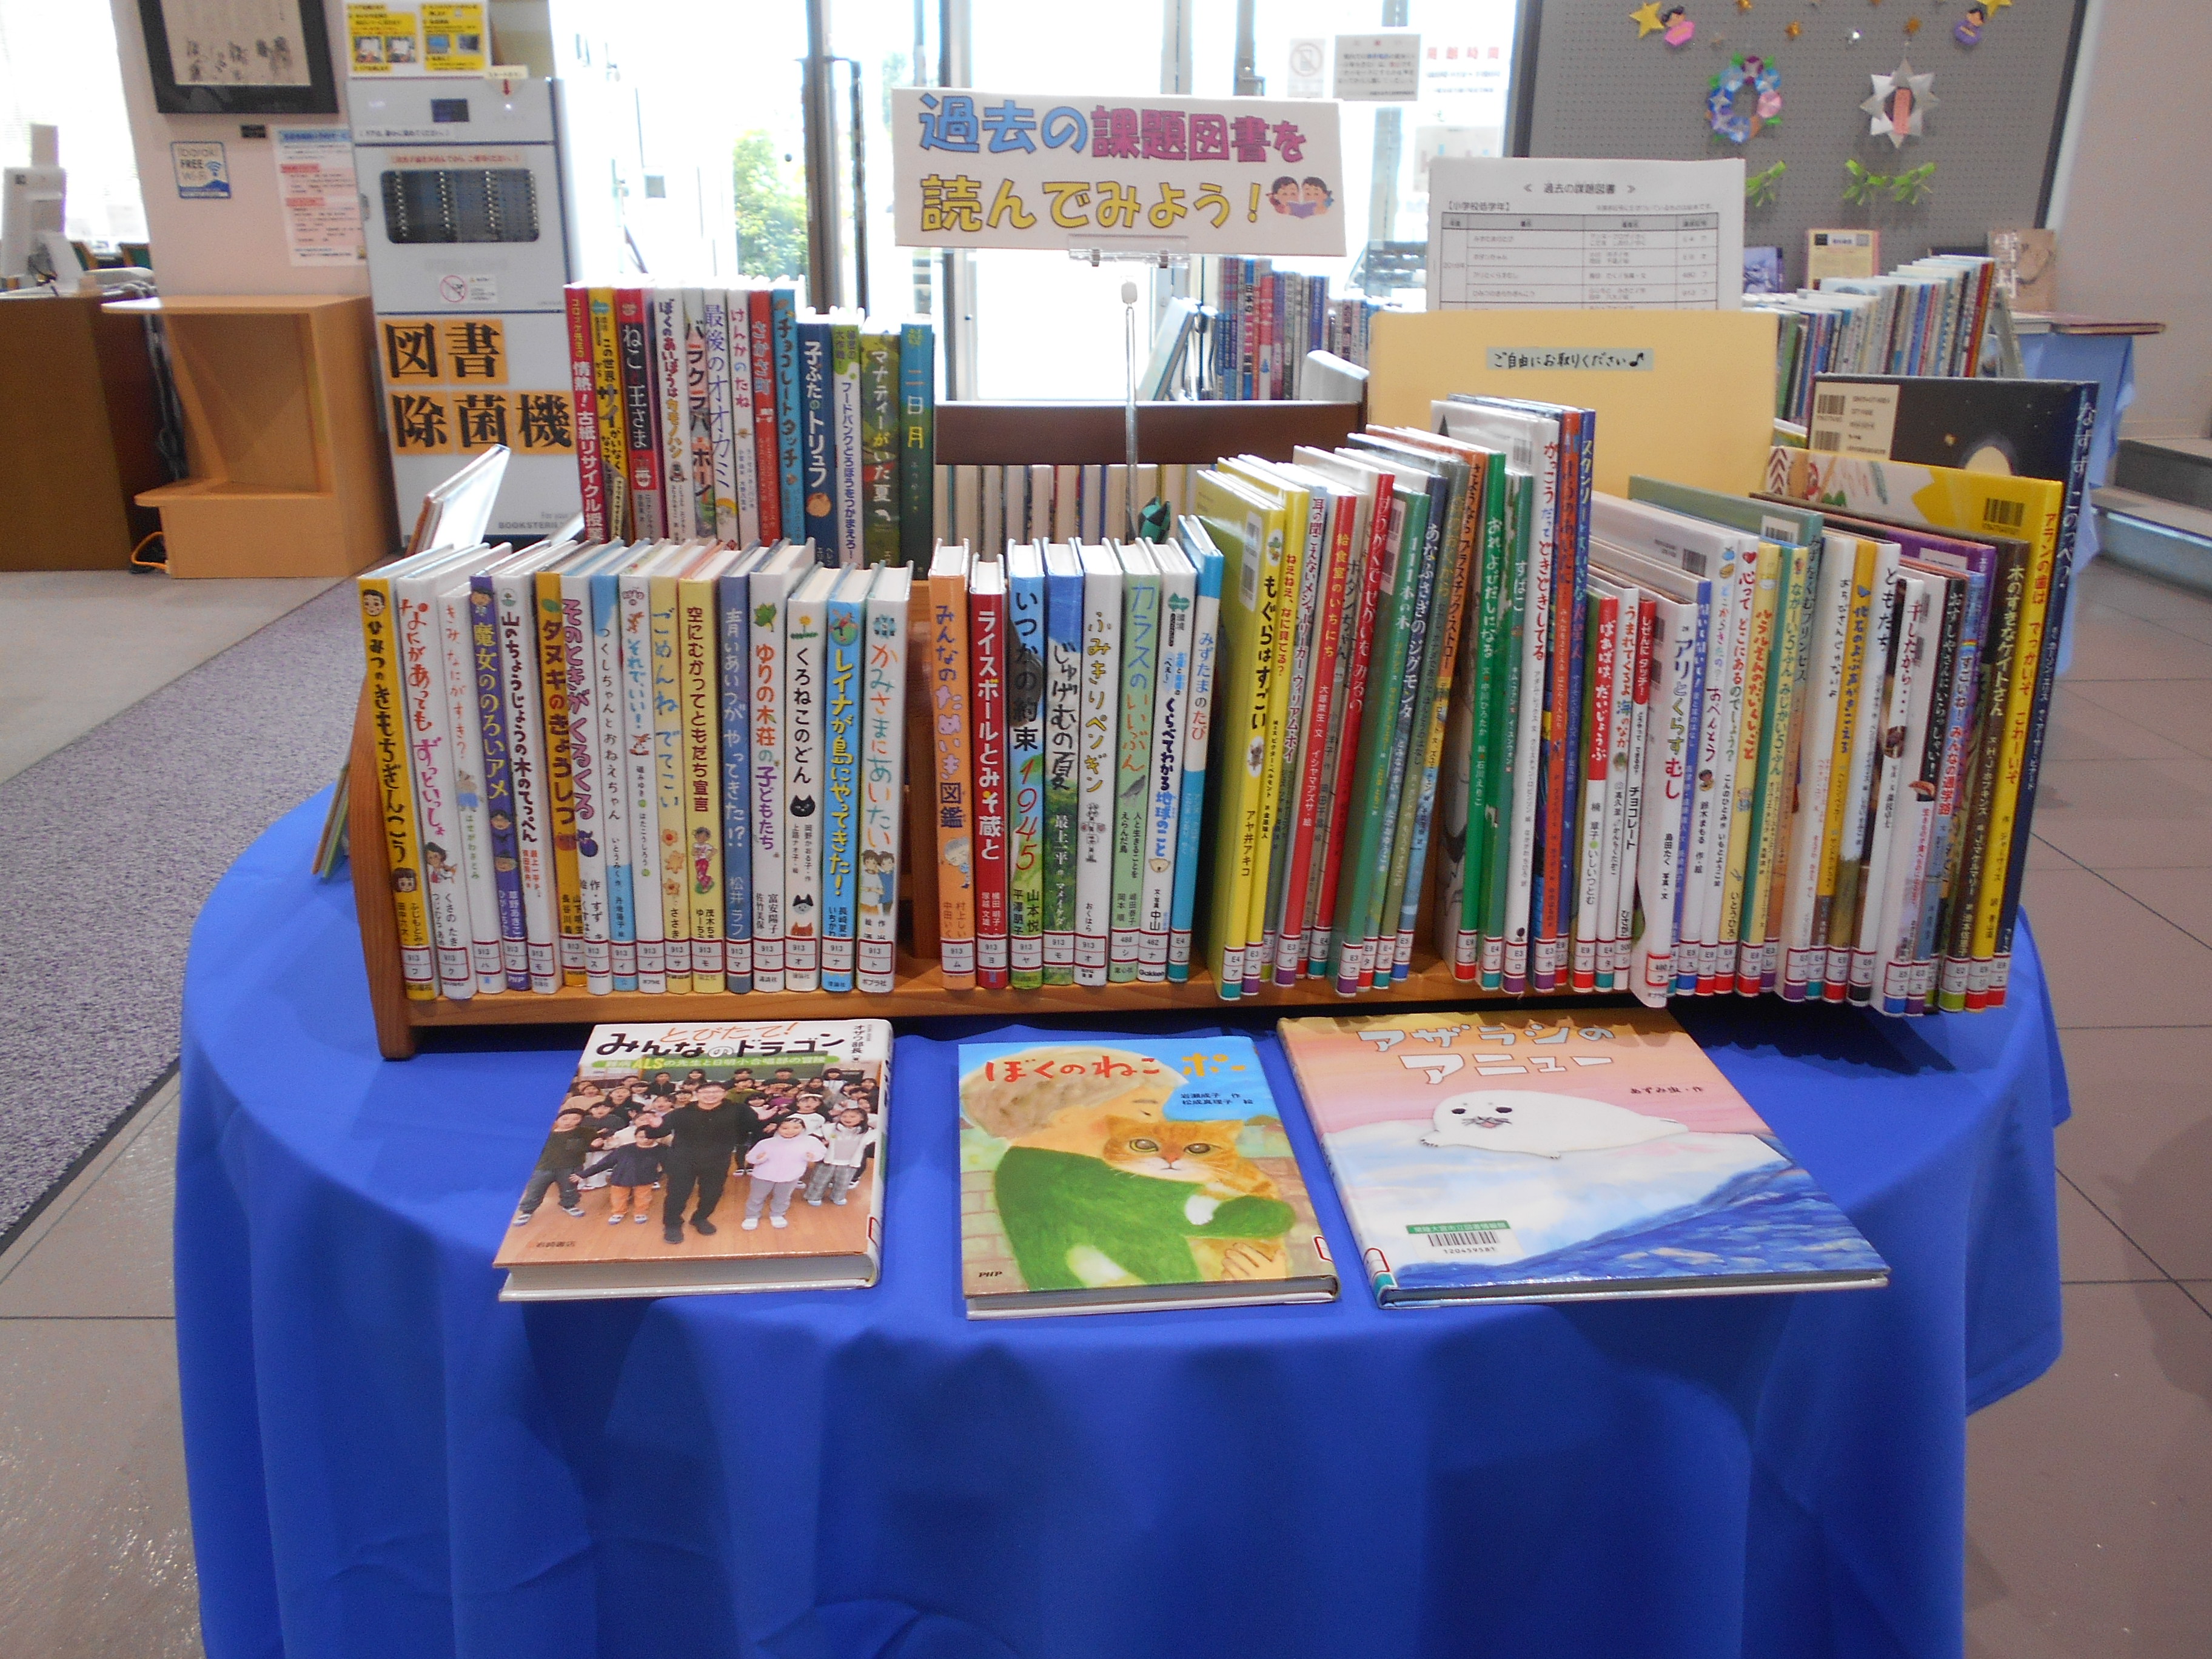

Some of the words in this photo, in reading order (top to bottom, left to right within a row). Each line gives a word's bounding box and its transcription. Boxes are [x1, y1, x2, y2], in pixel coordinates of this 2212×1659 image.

[919, 92, 1307, 163] 過去の課題図書を
[1543, 183, 1616, 195] 過去の課題図書
[920, 173, 1262, 232] 読んでみよう！
[385, 322, 500, 378] 図書
[706, 304, 731, 488] 最後のオオカミ
[731, 309, 751, 408] けんかのたね
[905, 369, 925, 449] 二日月
[391, 393, 572, 448] 除菌機
[804, 341, 828, 488] 子ぶたのトリュフ
[872, 350, 892, 502] マナティーがいた夏
[1325, 533, 1350, 657] 給食室のいちにち
[1513, 560, 1527, 611] すばこ
[1878, 568, 1897, 652] ともだち
[1989, 565, 2026, 717] 木のすきなケイトさん
[474, 622, 509, 800] 魔女ののろいアメ
[687, 606, 709, 813] 空にむかってともだち宣言
[1085, 612, 1111, 793] ふみきりペンギン
[1122, 581, 1155, 772] カラスのいいぶん
[1191, 632, 1213, 740] みずたまのたび
[1251, 575, 1278, 729] もぐらはすごい
[367, 620, 406, 862] ひみつのきもちぎんこう
[501, 611, 537, 843] 山のちょうじょうの木のてっぺん
[542, 622, 575, 825] タヌキのきょうしつ
[599, 628, 621, 820] つくしちゃんとおねえちゃん
[756, 643, 777, 850] ゆりの木荘の子どもたち
[793, 648, 812, 784] くろねこのどん
[830, 649, 853, 896] レイナが島にやってきた！
[866, 643, 899, 848] かみさまにあいたい
[935, 605, 963, 828] みんなのためいき図鑑
[977, 611, 1000, 860] ライスボールとみそ蔵と
[1051, 643, 1078, 791] じゅげむの夏
[1664, 638, 1694, 800] アリとくらすむし
[1706, 688, 1721, 762] おべんとう
[1585, 850, 1598, 905] いしいつとむ
[1626, 786, 1639, 850] チョコレート
[729, 876, 745, 936] 松井ラフ
[768, 893, 779, 934] 富安陽子
[1027, 888, 1040, 933] 山本悦
[595, 1032, 845, 1059] みんなのドラゴン
[659, 1022, 799, 1044] とびたて！
[985, 1054, 1159, 1084] ぼくのねこ
[1182, 1052, 1245, 1077] ポー
[1356, 1023, 1615, 1053] アザラシの
[1399, 1053, 1614, 1085] アニュー
